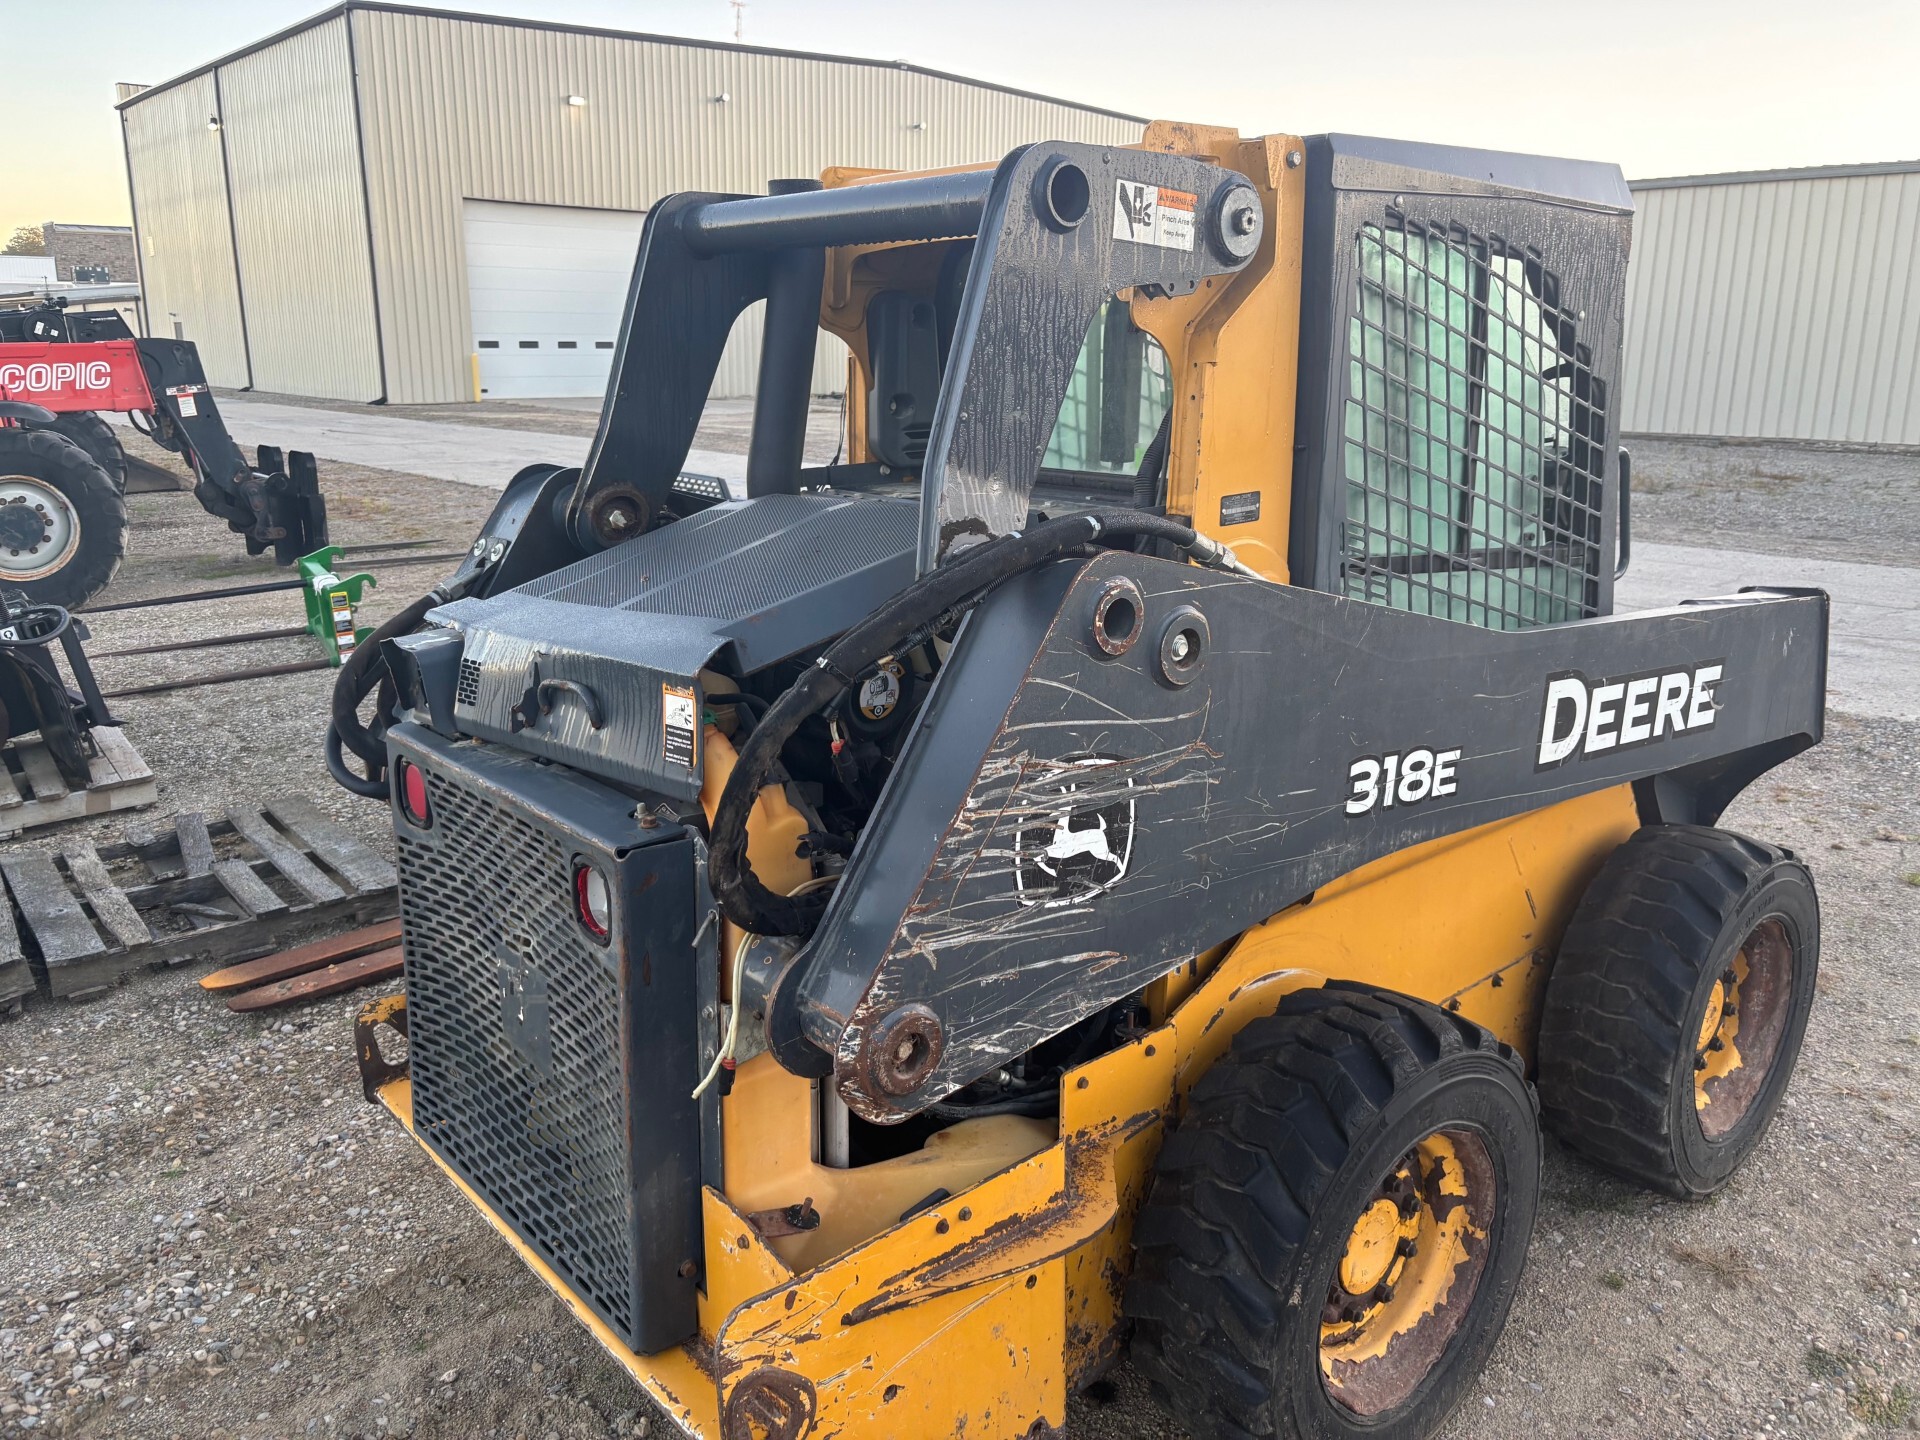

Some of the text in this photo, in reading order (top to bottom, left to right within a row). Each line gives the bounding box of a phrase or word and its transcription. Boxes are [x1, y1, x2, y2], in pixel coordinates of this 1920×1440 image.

[1161, 214, 1190, 226] Pinch Area
[1163, 229, 1187, 240] Keep Away
[0, 361, 111, 393] COPIC
[1538, 665, 1723, 765] DEERE
[1346, 749, 1462, 814] 318E
